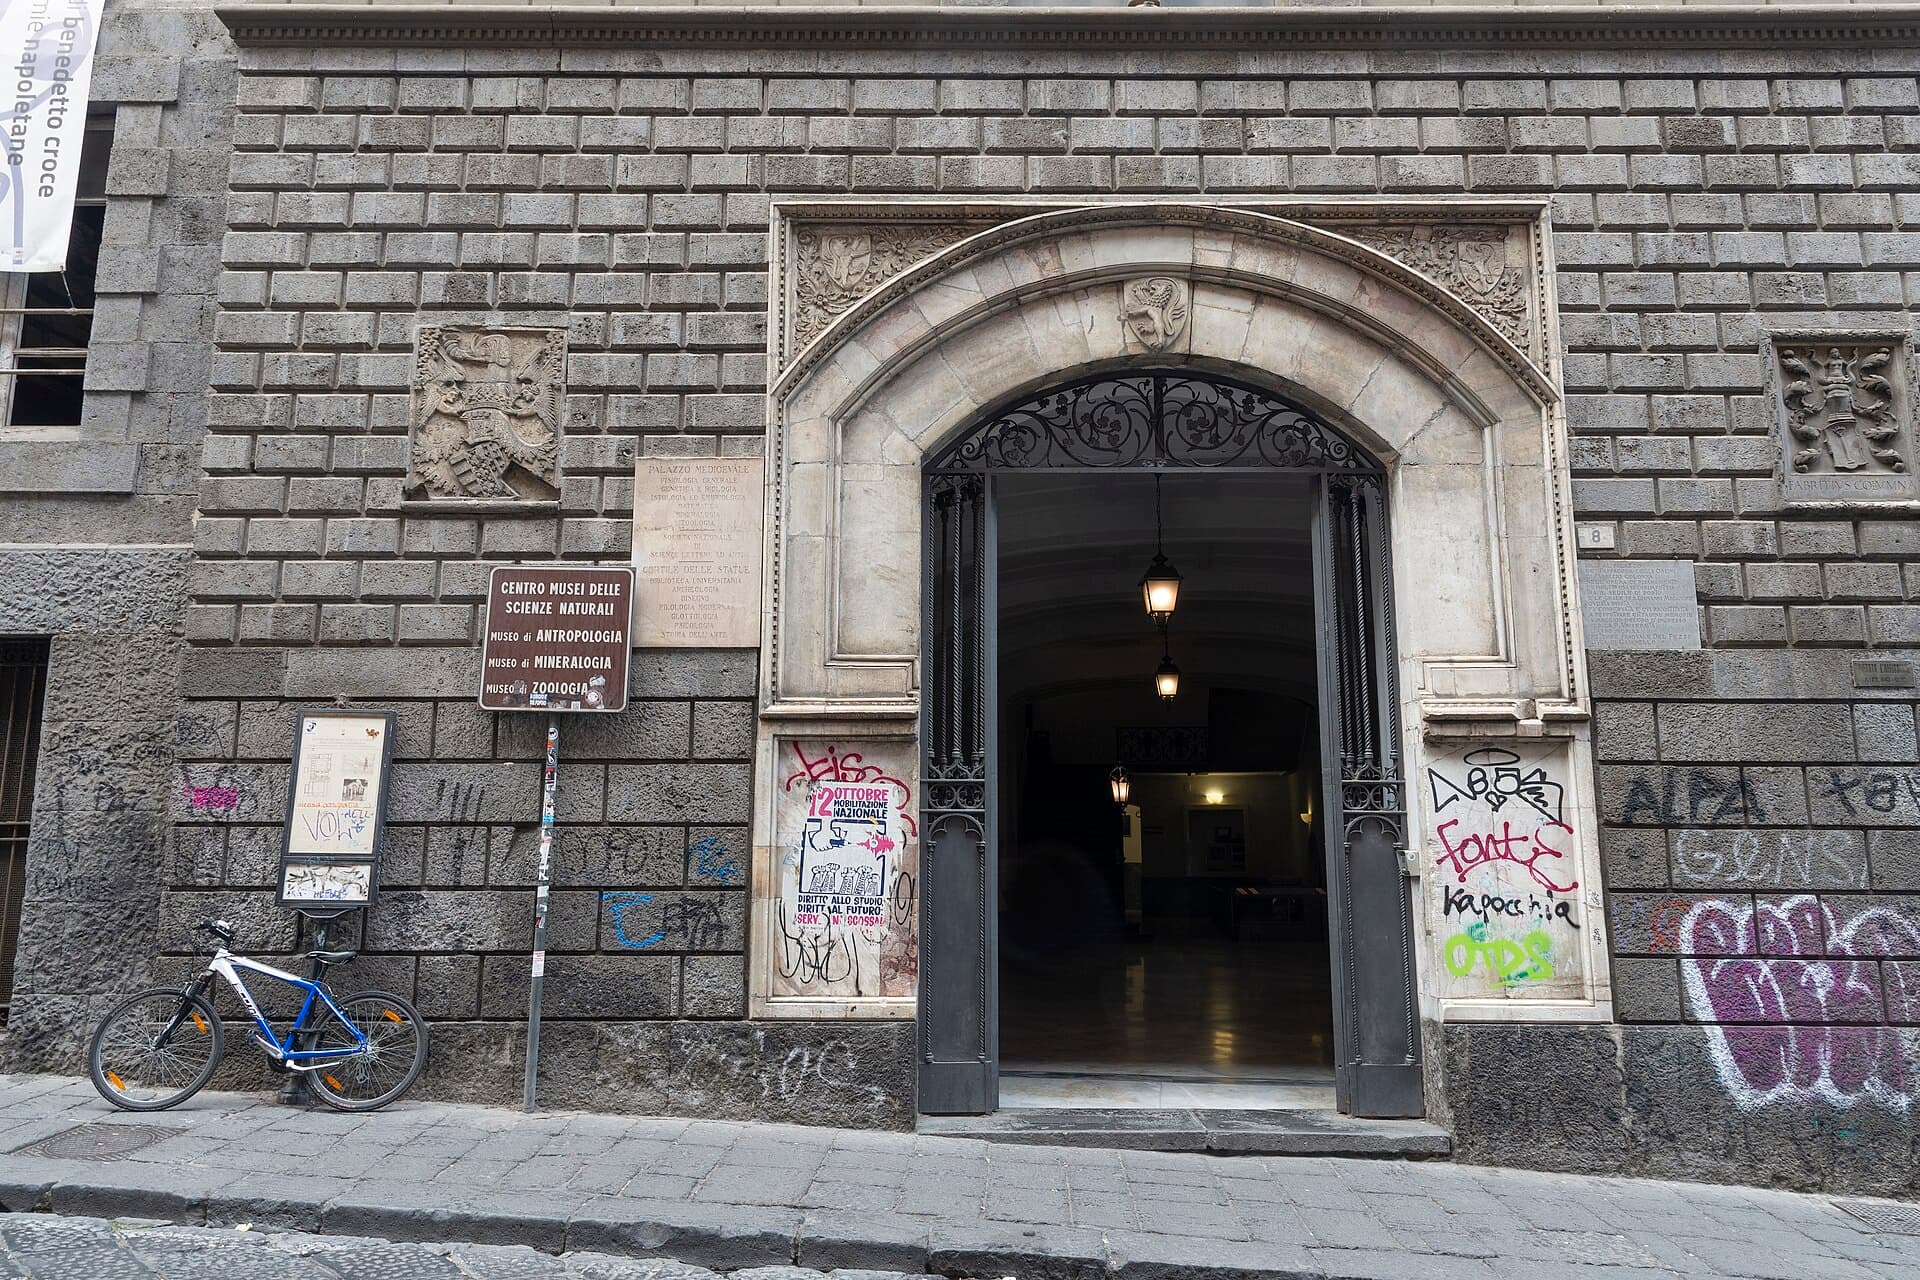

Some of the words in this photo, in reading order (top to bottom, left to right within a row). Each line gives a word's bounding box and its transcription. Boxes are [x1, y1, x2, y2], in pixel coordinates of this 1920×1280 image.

[46, 17, 84, 129] benedetto
[8, 39, 40, 166] napoletane
[38, 136, 61, 198] croce
[648, 465, 691, 474] PALAZZO
[1592, 530, 1601, 543] 8
[501, 582, 545, 595] CENTRO
[550, 583, 585, 596] MUSEI
[589, 583, 621, 596] DELLE
[505, 601, 553, 614] SCIENZE
[559, 602, 614, 616] NATURALI
[490, 631, 519, 642] MUSEO
[523, 632, 532, 642] di
[536, 629, 623, 643] ANTROPOLOGIA
[488, 658, 517, 668] MUSEO
[521, 658, 530, 668] di
[534, 655, 612, 670] MINERALOGIA
[486, 683, 515, 694] MUSEO
[519, 684, 528, 694] di
[532, 681, 589, 696] ZOOLOGIA
[808, 787, 836, 817] 12
[834, 787, 889, 802] OTTOBRE
[833, 799, 889, 809] MOBILITAZIONE
[833, 807, 888, 819] NAZIONALE
[831, 896, 850, 905] ALLO
[797, 904, 825, 914] DIRITT
[831, 904, 843, 914] AL
[797, 914, 821, 925] SERV
